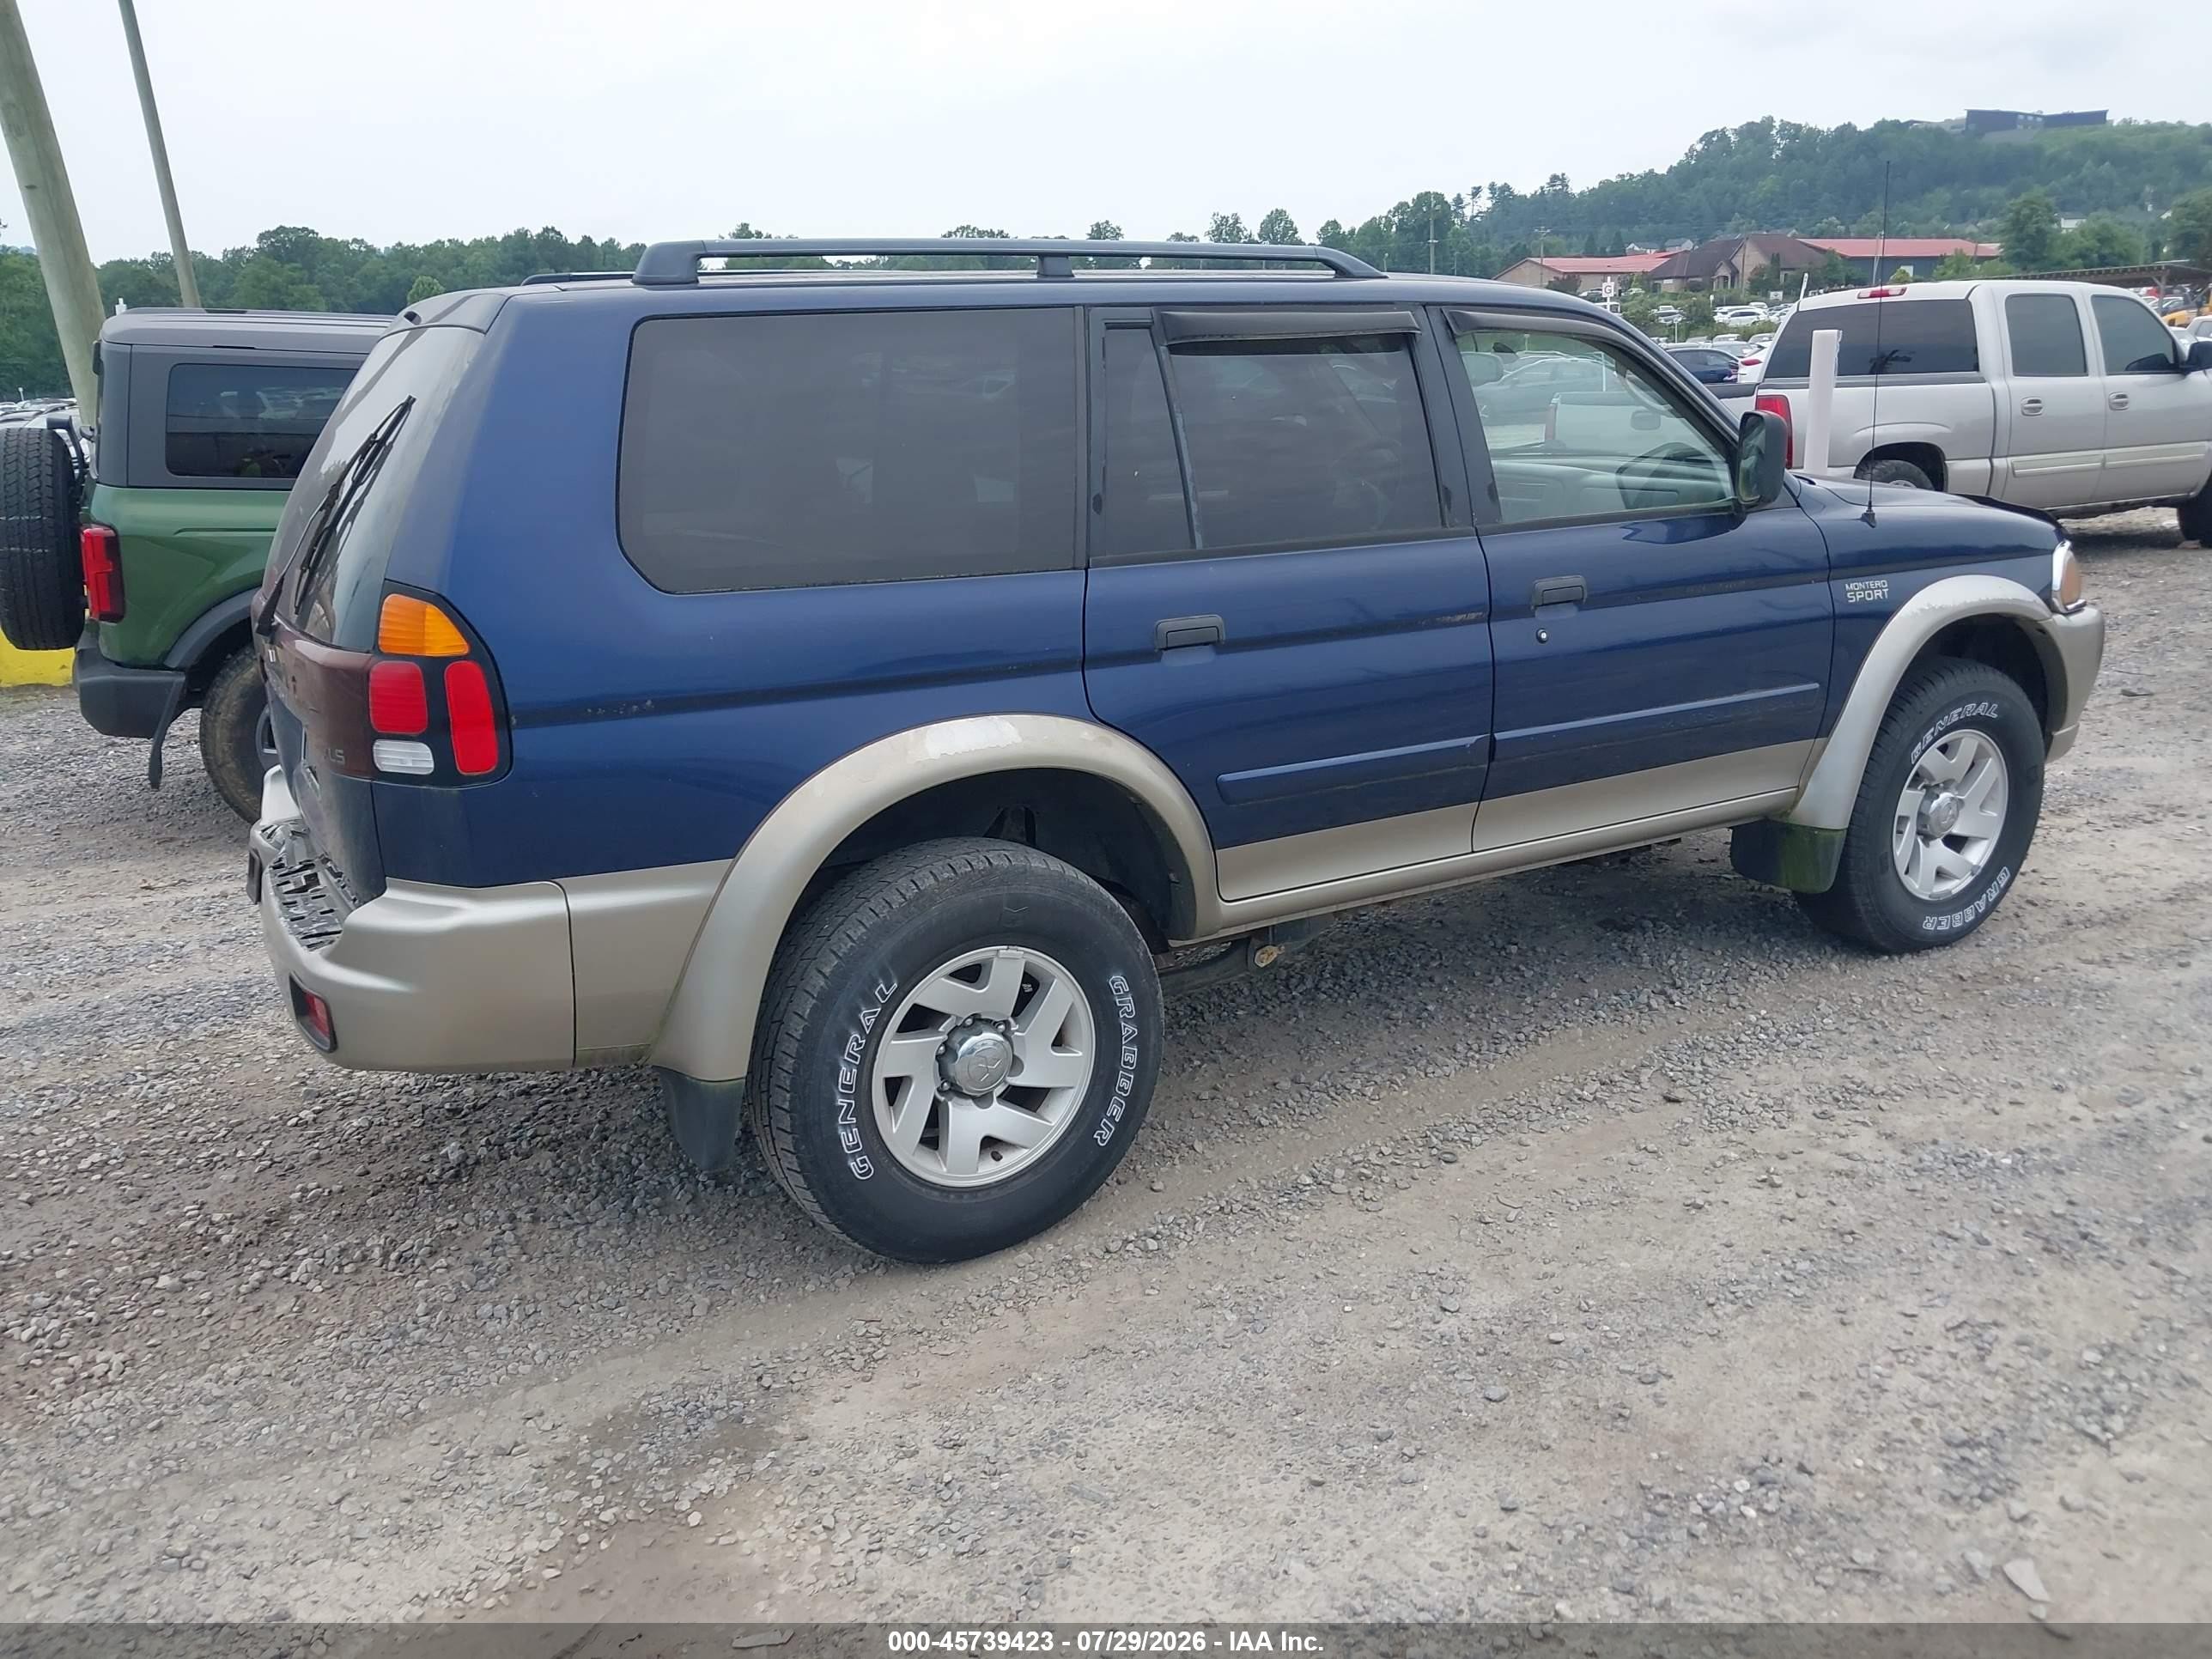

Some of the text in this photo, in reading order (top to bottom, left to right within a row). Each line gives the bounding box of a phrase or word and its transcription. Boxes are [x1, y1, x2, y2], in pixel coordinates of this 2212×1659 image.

[1604, 285, 1613, 295] G
[1844, 580, 1888, 592] MONTERO
[1846, 588, 1889, 603] SPORT
[1911, 702, 1999, 763] GENERAL
[1923, 866, 2011, 932] GRABBER
[837, 980, 898, 1181] GENERAL
[1092, 975, 1138, 1148] GRABBER
